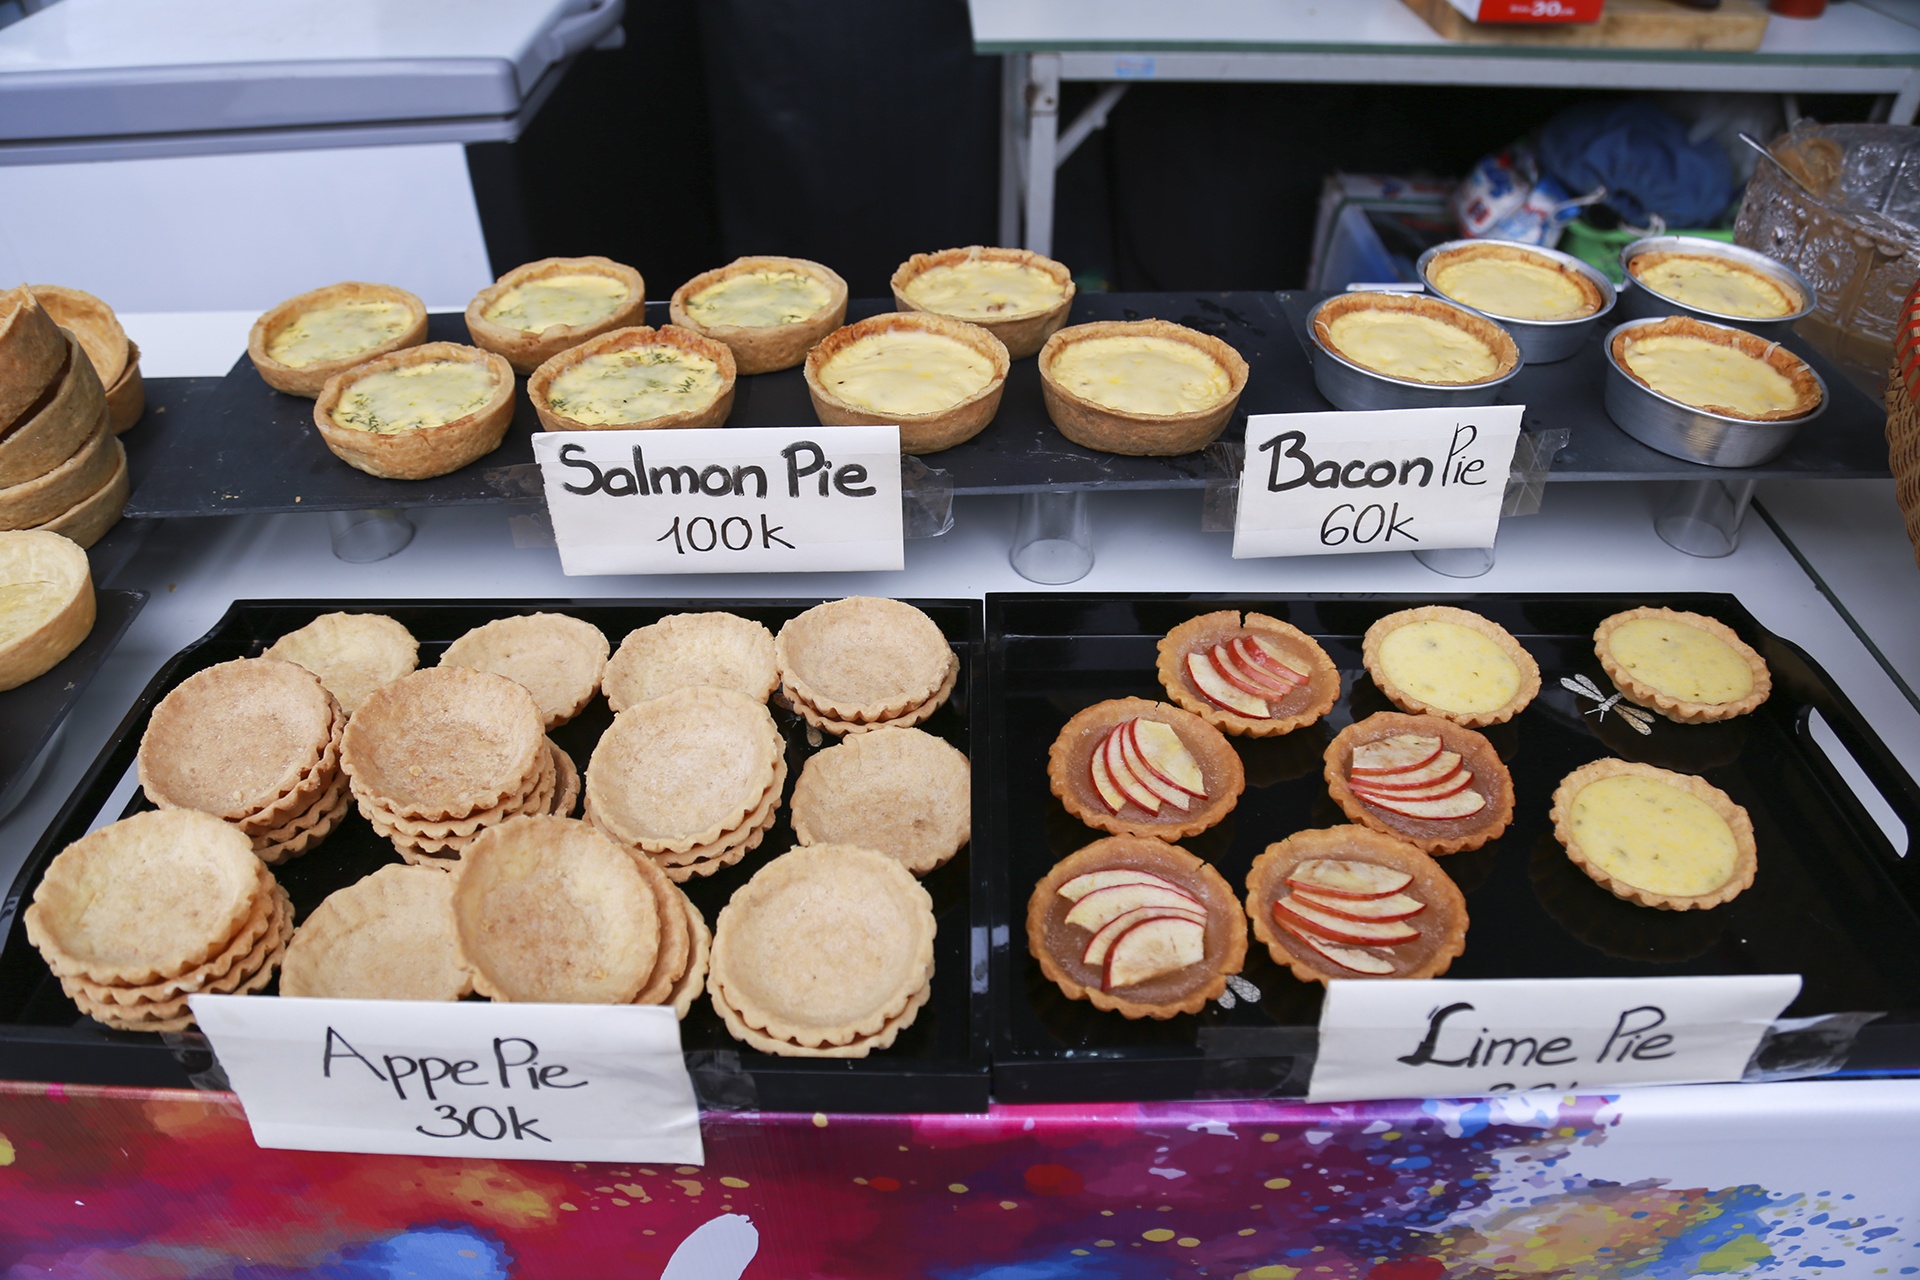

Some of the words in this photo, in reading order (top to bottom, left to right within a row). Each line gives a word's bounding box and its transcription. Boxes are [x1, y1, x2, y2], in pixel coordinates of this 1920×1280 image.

[560, 444, 768, 498] Salmon
[781, 440, 877, 497] Pie
[1259, 430, 1434, 493] Bacon
[1441, 423, 1487, 487] Pie
[323, 1026, 489, 1100] Appe
[493, 1037, 589, 1090] Pie
[1398, 1002, 1578, 1067] Lime
[1596, 1005, 1676, 1063] Pie
